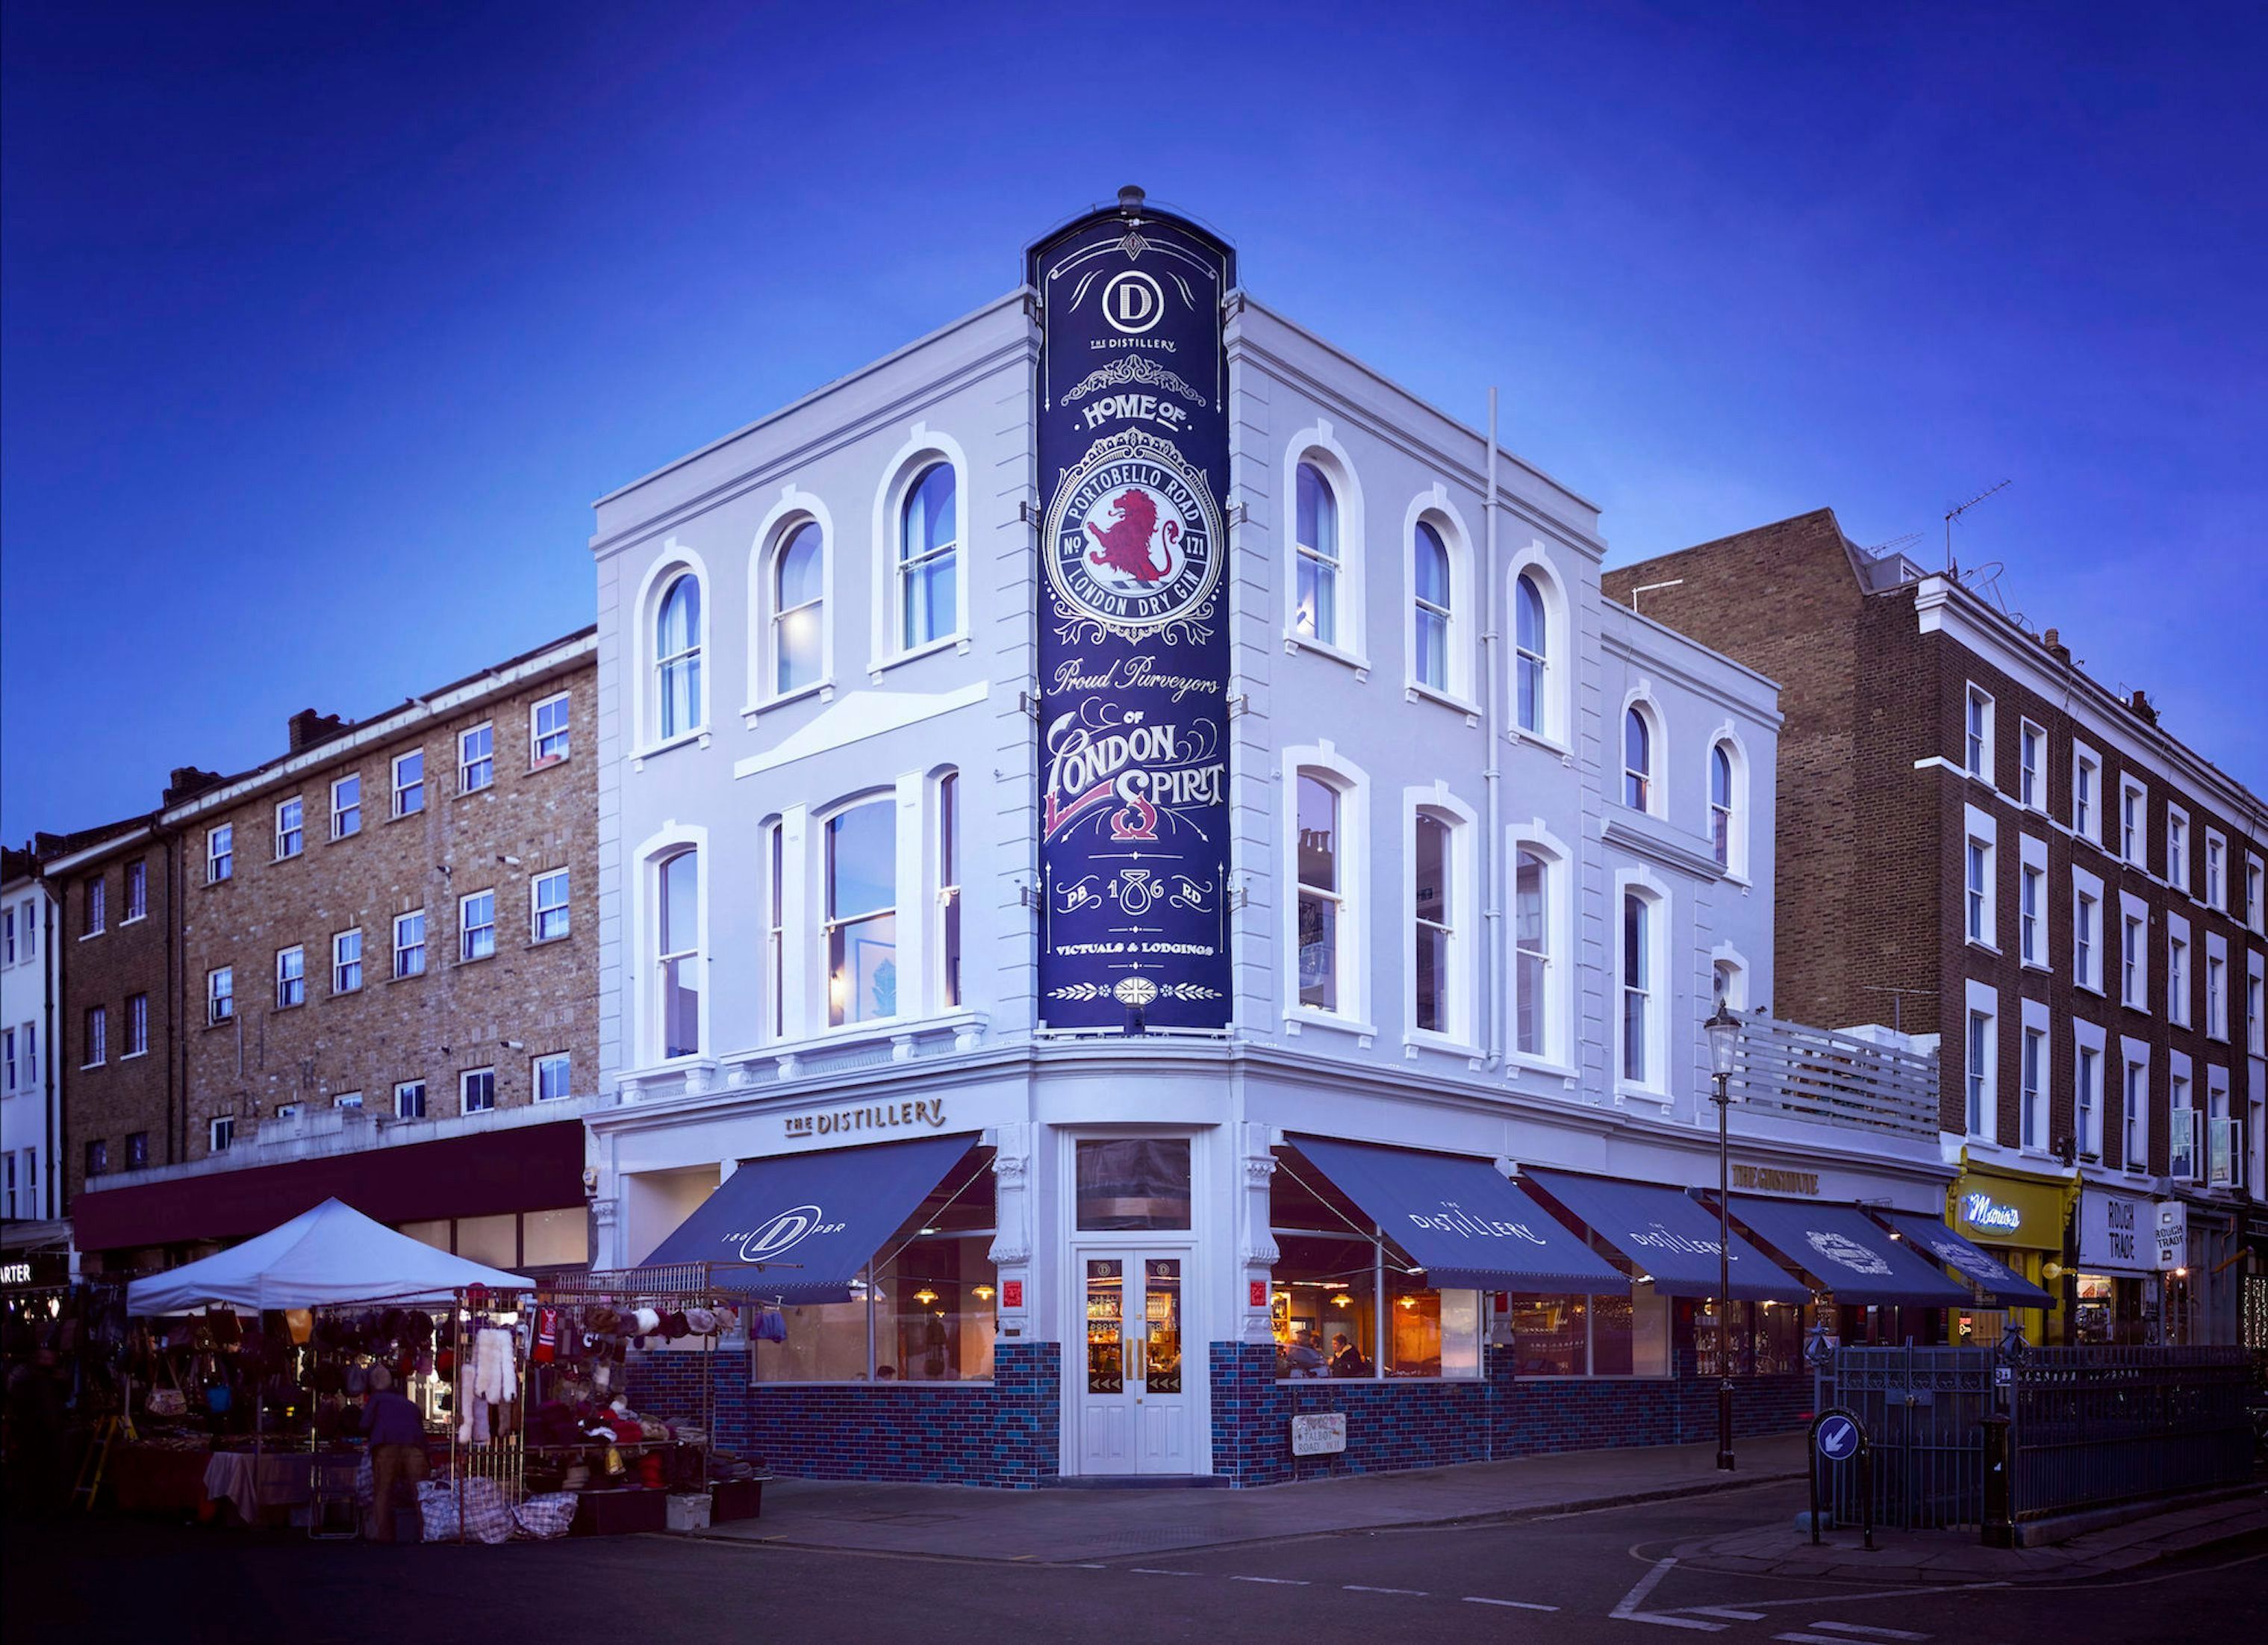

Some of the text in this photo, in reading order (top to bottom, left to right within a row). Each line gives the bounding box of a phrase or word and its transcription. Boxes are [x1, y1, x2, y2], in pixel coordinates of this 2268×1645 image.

[1119, 284, 1153, 320] D
[1091, 338, 1177, 352] THE DISTILLERY
[1082, 394, 1187, 430] HOME OF
[1068, 464, 1200, 522] PORTOBELLO ROAD
[1186, 536, 1205, 556] 171
[1068, 567, 1200, 616] LONDON DRY GIN
[1047, 655, 1221, 703] Proud Purveyors
[1123, 711, 1144, 724] OF
[1110, 763, 1225, 841] SPIRIT
[1067, 886, 1088, 908] PB
[1182, 883, 1202, 904] RD
[1056, 942, 1214, 957] VICTUALS & LODGINGS
[785, 1098, 947, 1134] THE DISTILLERY
[1409, 1208, 1547, 1245] DISTILLERY
[2107, 1201, 2134, 1231] ROUGH
[751, 1216, 809, 1252] D
[811, 1223, 846, 1235] PBR
[2109, 1232, 2135, 1260] TRADE
[1298, 1441, 1319, 1452] ROAD
[1303, 1431, 1333, 1442] TALBOT
